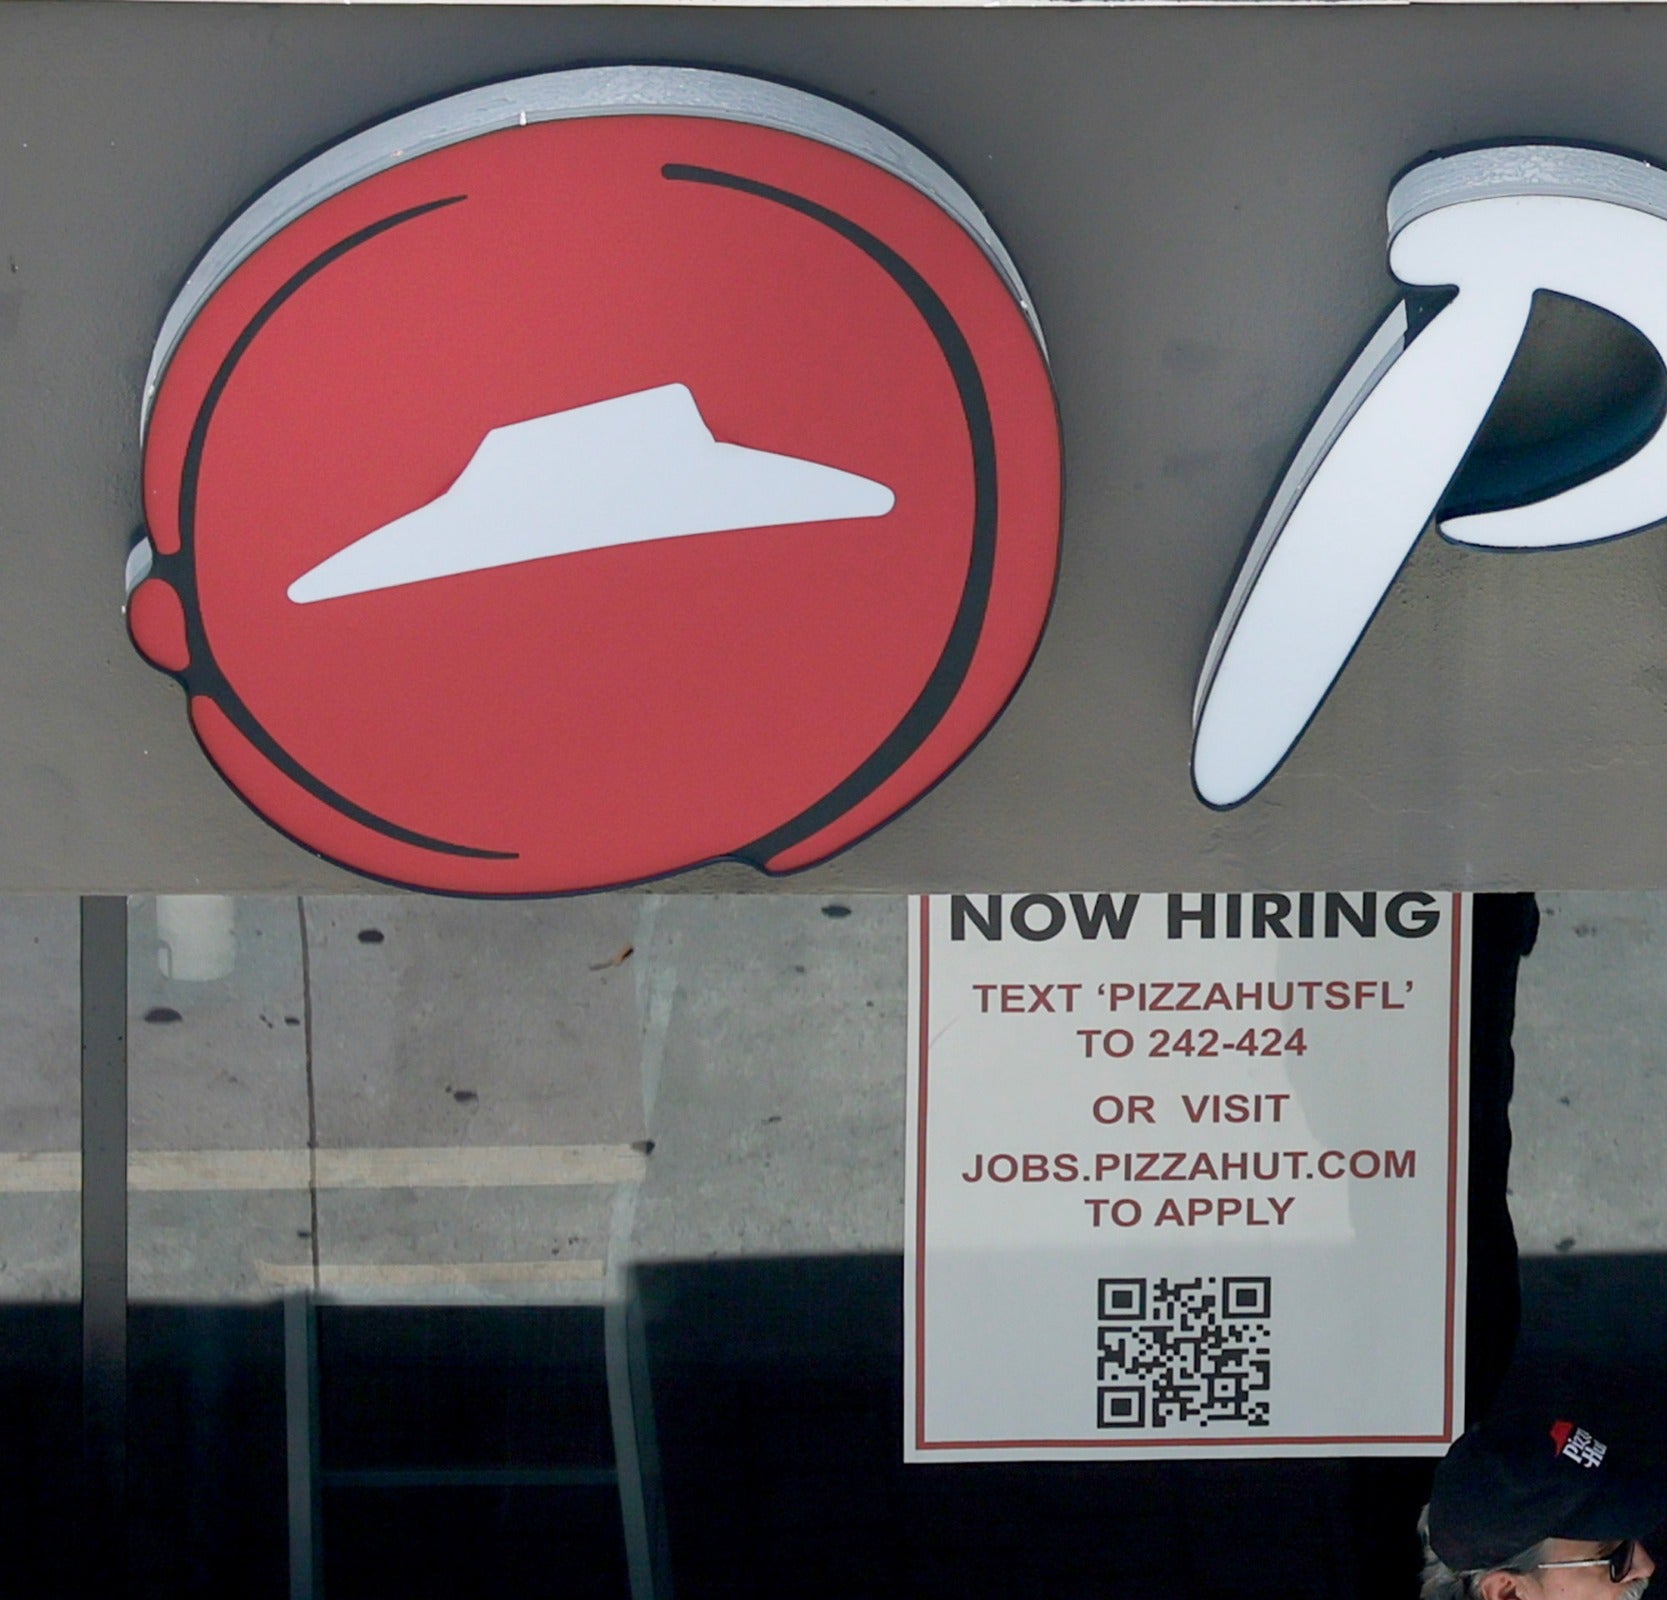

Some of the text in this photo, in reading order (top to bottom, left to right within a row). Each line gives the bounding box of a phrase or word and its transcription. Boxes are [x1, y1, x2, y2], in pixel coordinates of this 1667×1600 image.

[951, 891, 1441, 941] NOW HIRING
[972, 984, 1082, 1013] TEXT
[1077, 1027, 1307, 1057] TO 242-424
[1093, 1093, 1290, 1124] OR VISIT
[962, 1149, 1417, 1182] JOBS.PIZZAHUT.COM
[1084, 1197, 1296, 1227] TO APPLY
